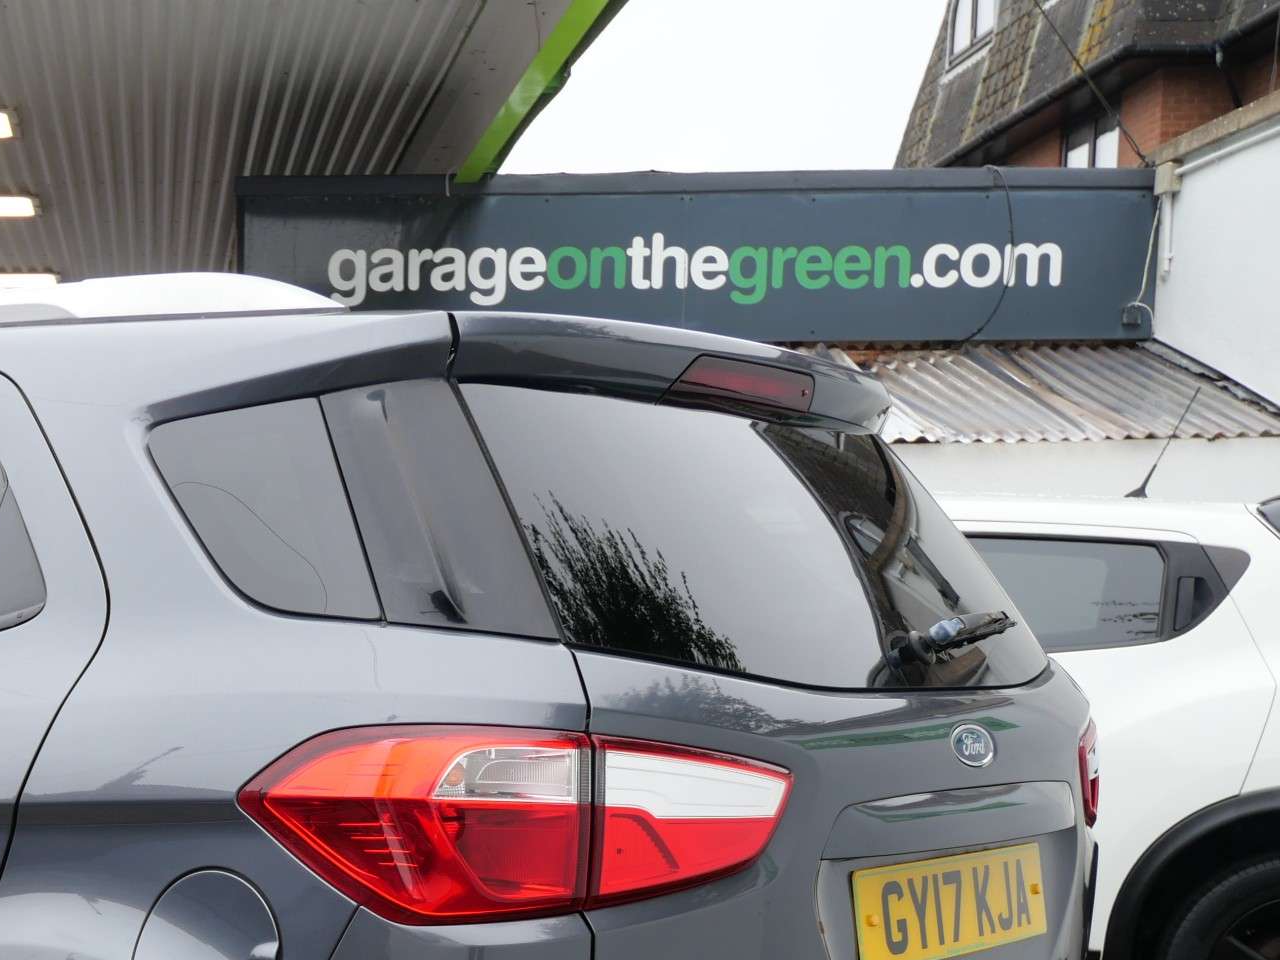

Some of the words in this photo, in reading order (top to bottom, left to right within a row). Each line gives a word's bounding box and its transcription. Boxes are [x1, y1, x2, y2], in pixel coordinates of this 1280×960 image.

[327, 232, 1064, 306] garageonthegreen.com
[962, 732, 985, 756] Ford
[881, 870, 962, 955] GY17
[972, 859, 1031, 937] KJA
